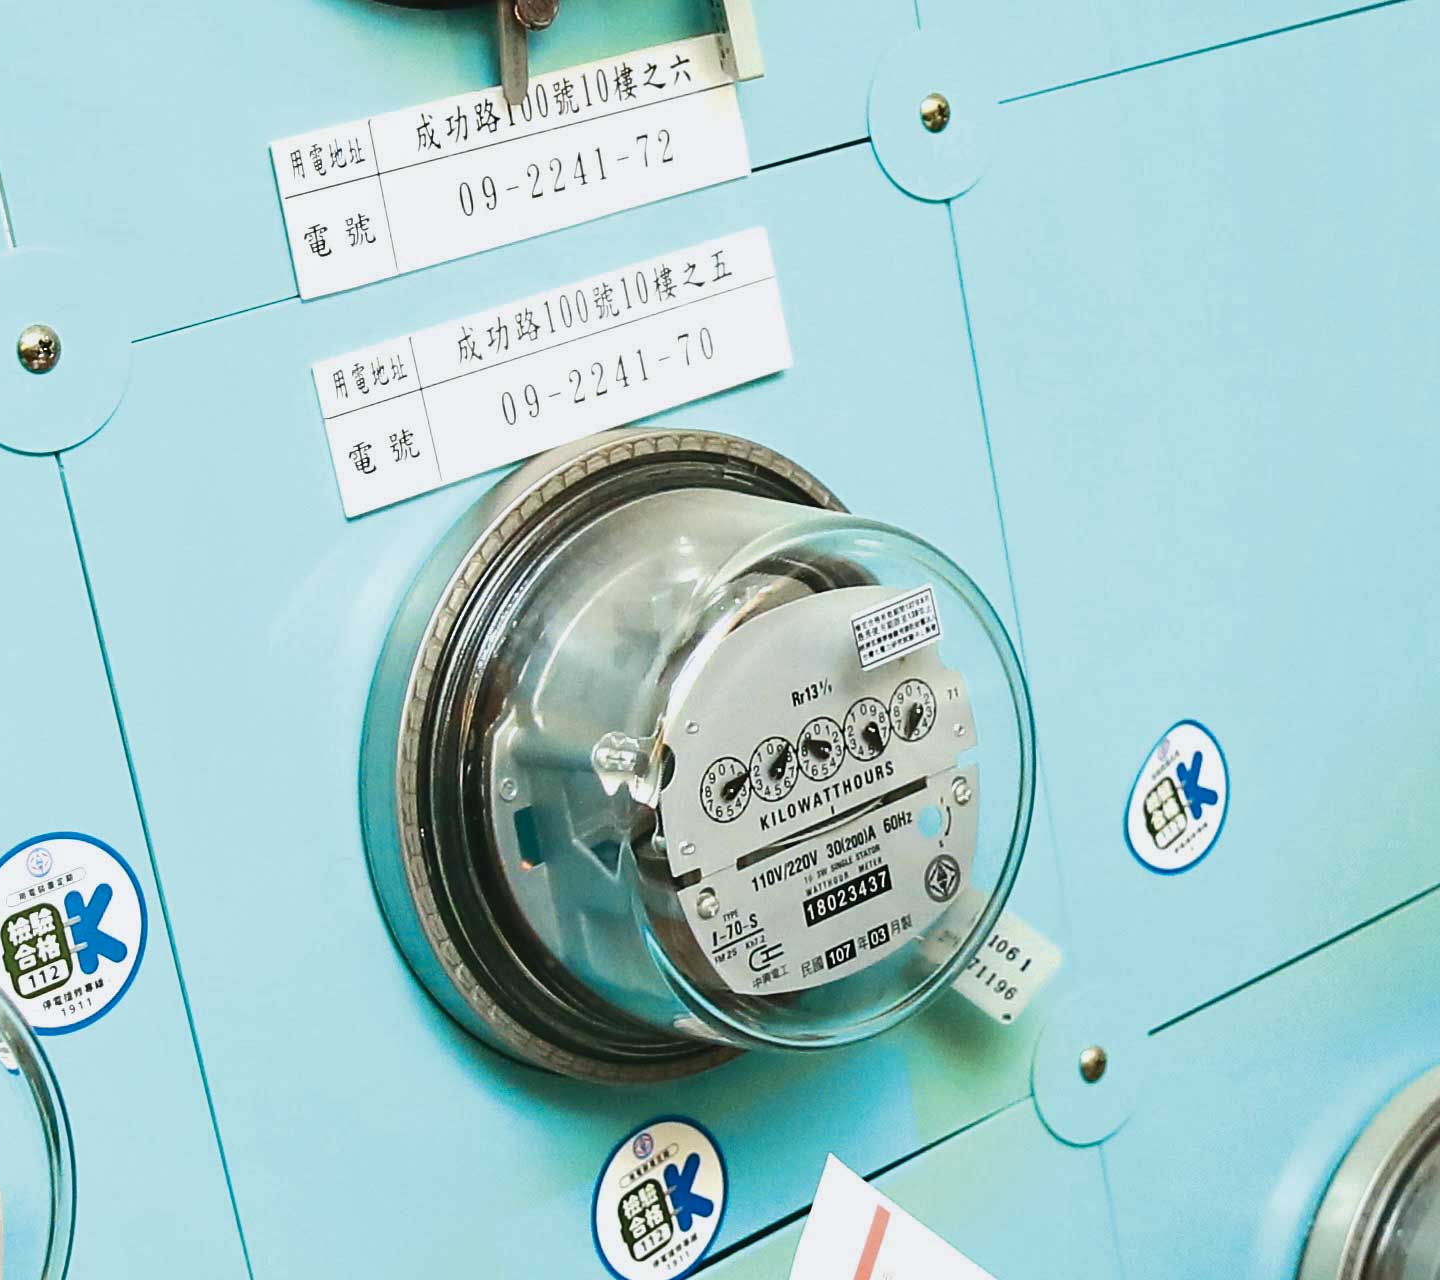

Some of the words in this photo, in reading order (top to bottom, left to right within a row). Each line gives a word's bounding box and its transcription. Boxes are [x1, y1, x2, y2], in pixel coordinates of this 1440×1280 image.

[416, 54, 692, 153] 成功路100號10樓之六
[290, 136, 366, 180] 用電地址
[458, 127, 675, 218] 09-2241-72
[303, 212, 377, 258] 電號
[456, 248, 733, 365] 成功路100號10樓之五
[332, 353, 408, 400] 用電地址
[500, 326, 715, 427] 09-2241-70
[348, 427, 420, 476] 電號
[947, 687, 959, 701] 71
[759, 760, 896, 832] KILOWATTHOURS
[1176, 751, 1218, 820] K
[752, 849, 818, 892] 110V/220V
[825, 825, 877, 861] 30(200)A
[883, 811, 914, 834] 60Hz
[831, 858, 855, 876] SINGLE
[855, 844, 881, 863] STATOR
[805, 872, 850, 897] WATTHOUR
[858, 856, 883, 873] METER
[806, 870, 888, 921] 18023437
[7, 907, 55, 946] 檢驗
[64, 883, 128, 975] K
[711, 912, 759, 946] I-70-S
[722, 909, 739, 922] TYPE
[14, 934, 61, 971] 合格
[801, 955, 825, 978] 民國
[829, 944, 852, 966] 107
[857, 936, 868, 952] 年
[869, 927, 887, 946] 03
[890, 914, 913, 936] 月製
[988, 934, 1020, 961] 106
[28, 965, 60, 989] 112
[61, 999, 93, 1017] 1911
[663, 1153, 714, 1232] K
[640, 1229, 664, 1252] 112
